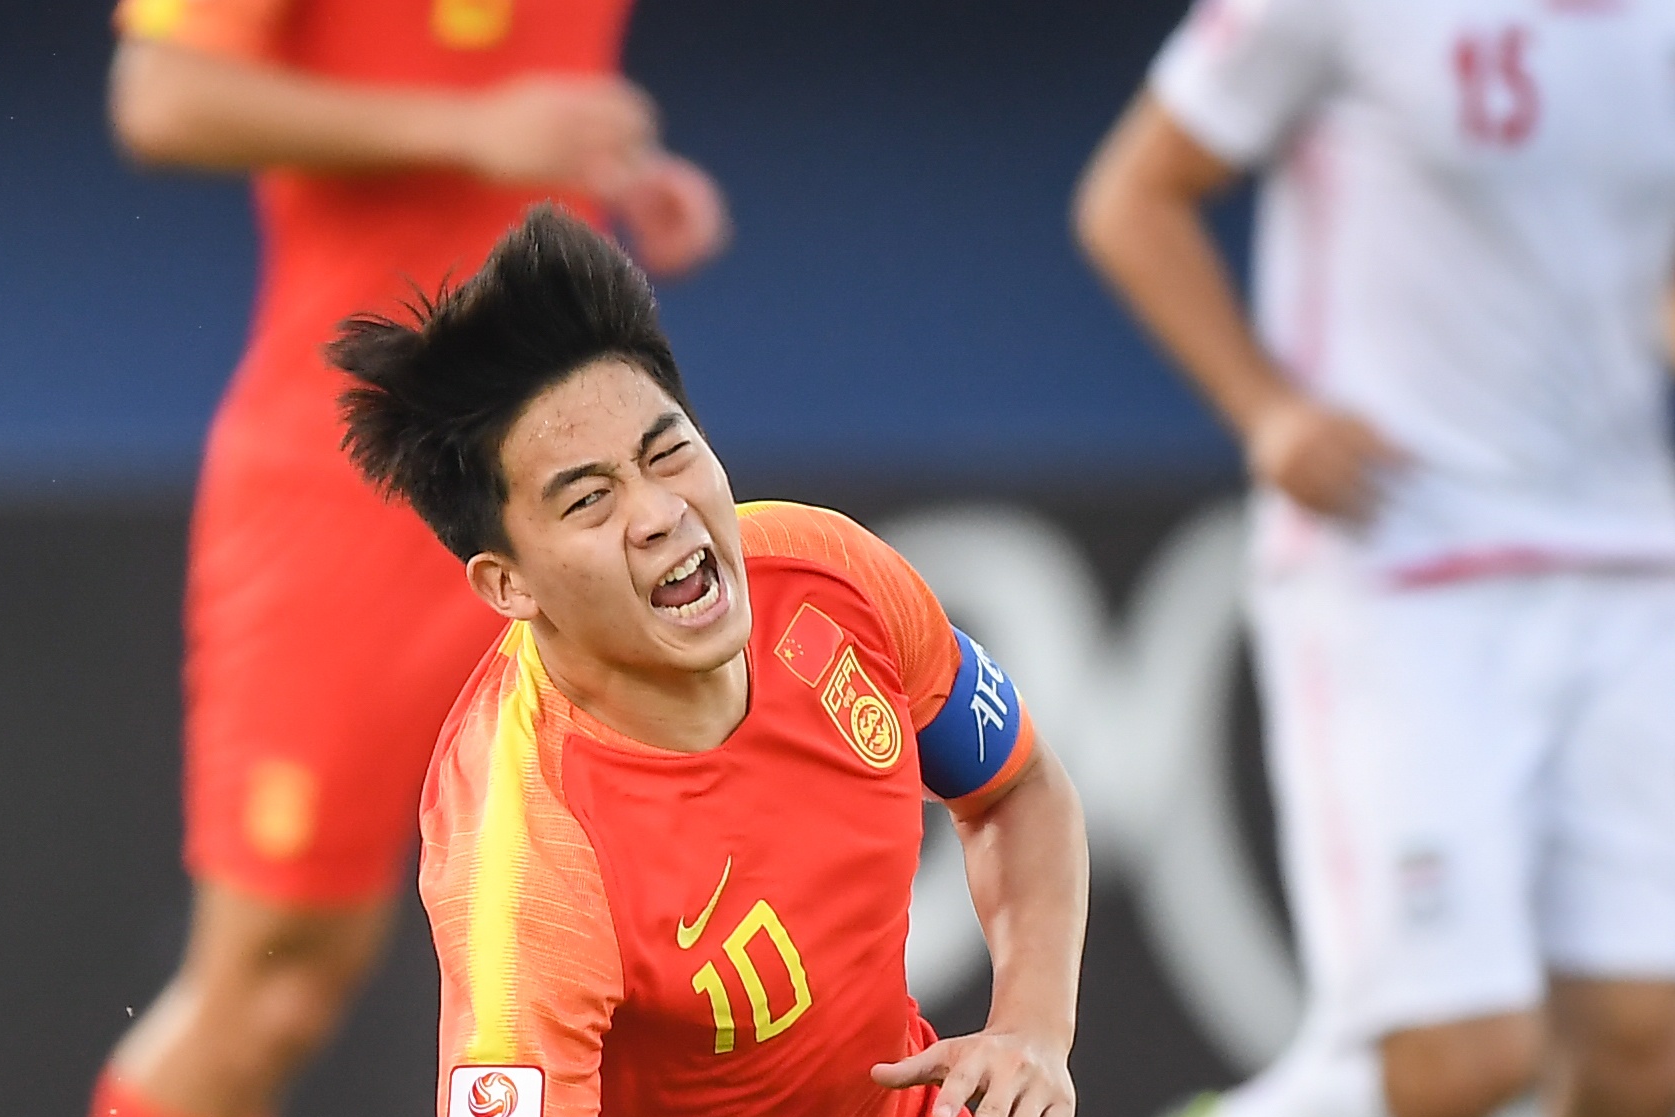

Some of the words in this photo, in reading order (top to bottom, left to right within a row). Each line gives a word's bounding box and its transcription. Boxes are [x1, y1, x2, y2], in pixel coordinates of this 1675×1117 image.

[1450, 28, 1544, 148] 15
[827, 657, 856, 713] CFA
[691, 899, 813, 1055] 10
